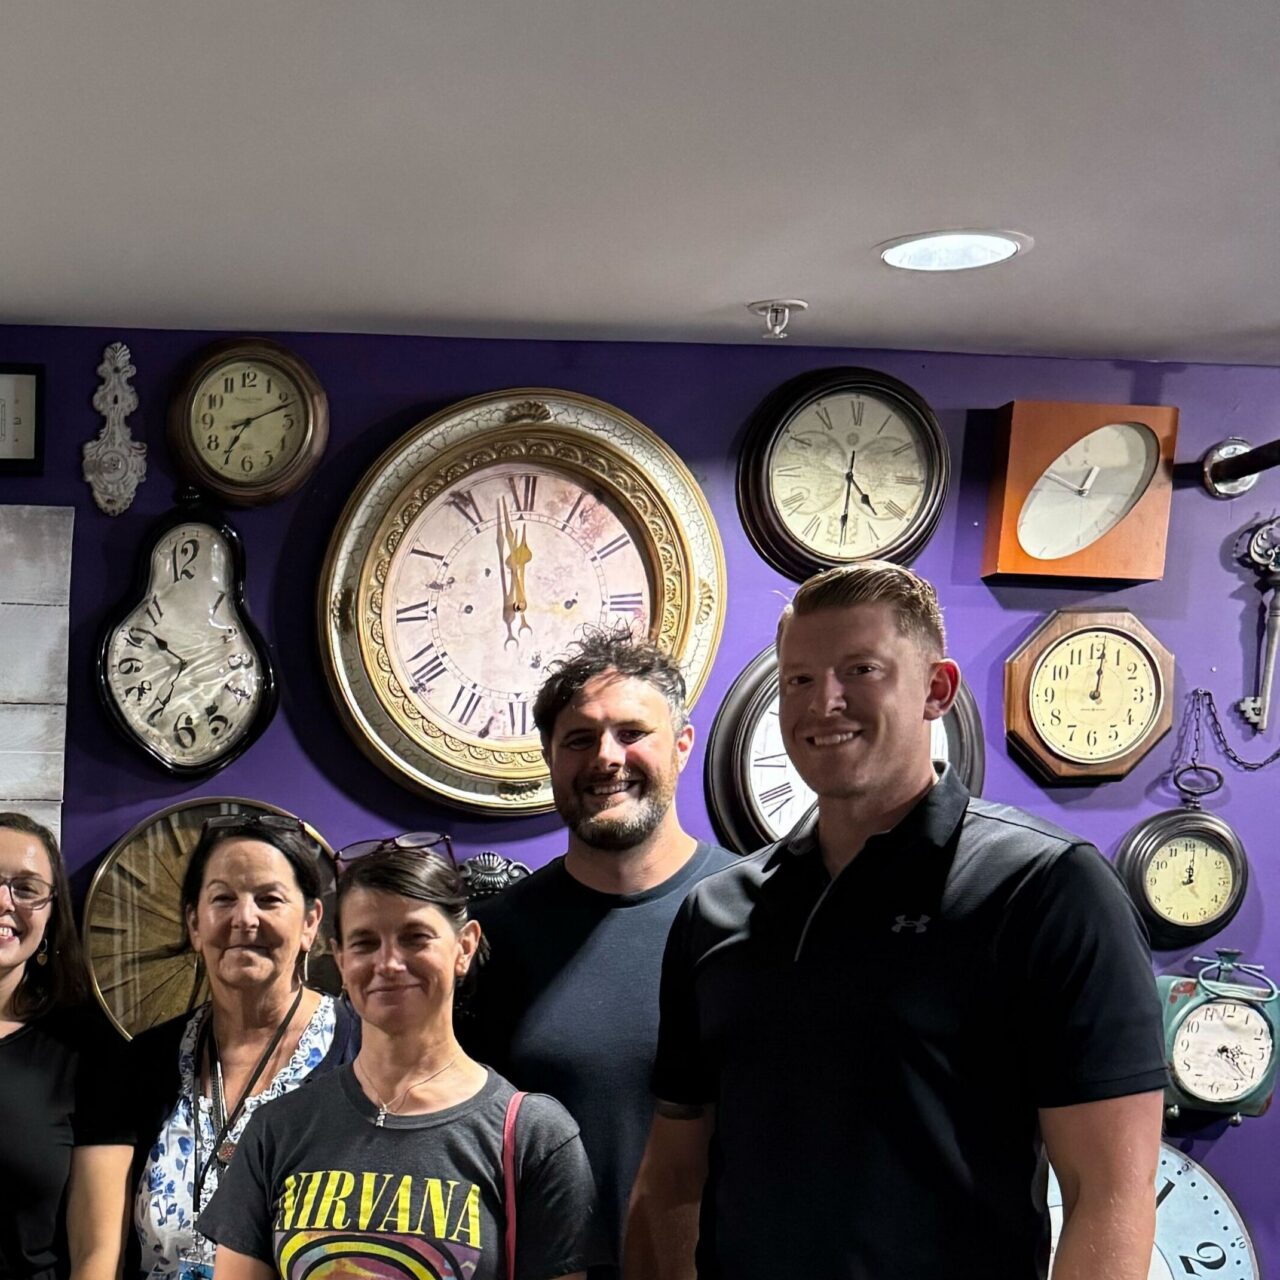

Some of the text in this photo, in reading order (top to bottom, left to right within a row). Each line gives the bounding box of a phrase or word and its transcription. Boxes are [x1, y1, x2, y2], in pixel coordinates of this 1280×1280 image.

[224, 378, 234, 394] 11
[241, 371, 257, 388] 12
[267, 378, 272, 394] 1
[207, 394, 224, 410] 10
[202, 413, 214, 430] 9
[283, 414, 294, 430] 3
[206, 434, 220, 451] 8
[241, 456, 253, 472] 6
[261, 450, 273, 467] 5
[170, 538, 200, 583] 12
[145, 594, 164, 626] 11
[1069, 648, 1082, 665] 11
[1088, 643, 1106, 660] 12
[1115, 648, 1121, 666] 1
[118, 657, 144, 675] 9
[1052, 664, 1069, 680] 10
[1126, 662, 1138, 680] 2
[1044, 686, 1055, 704] 9
[1133, 686, 1144, 703] 3
[205, 702, 233, 739] 5
[1050, 708, 1062, 726] 8
[1123, 708, 1134, 725] 4
[173, 711, 196, 749] 6
[1067, 724, 1077, 741] 7
[1086, 729, 1097, 746] 6
[1108, 724, 1119, 741] 5
[1169, 848, 1178, 857] 11
[1204, 847, 1209, 857] 1
[1156, 860, 1168, 870] 10
[1150, 877, 1157, 886] 9
[1165, 906, 1173, 915] 7
[1186, 1020, 1200, 1033] 10
[1181, 1040, 1190, 1052] 9
[1181, 1161, 1193, 1173] 5
[275, 1170, 483, 1249] NIRVANA
[1235, 1235, 1247, 1249] 10
[1178, 1241, 1227, 1278] 2
